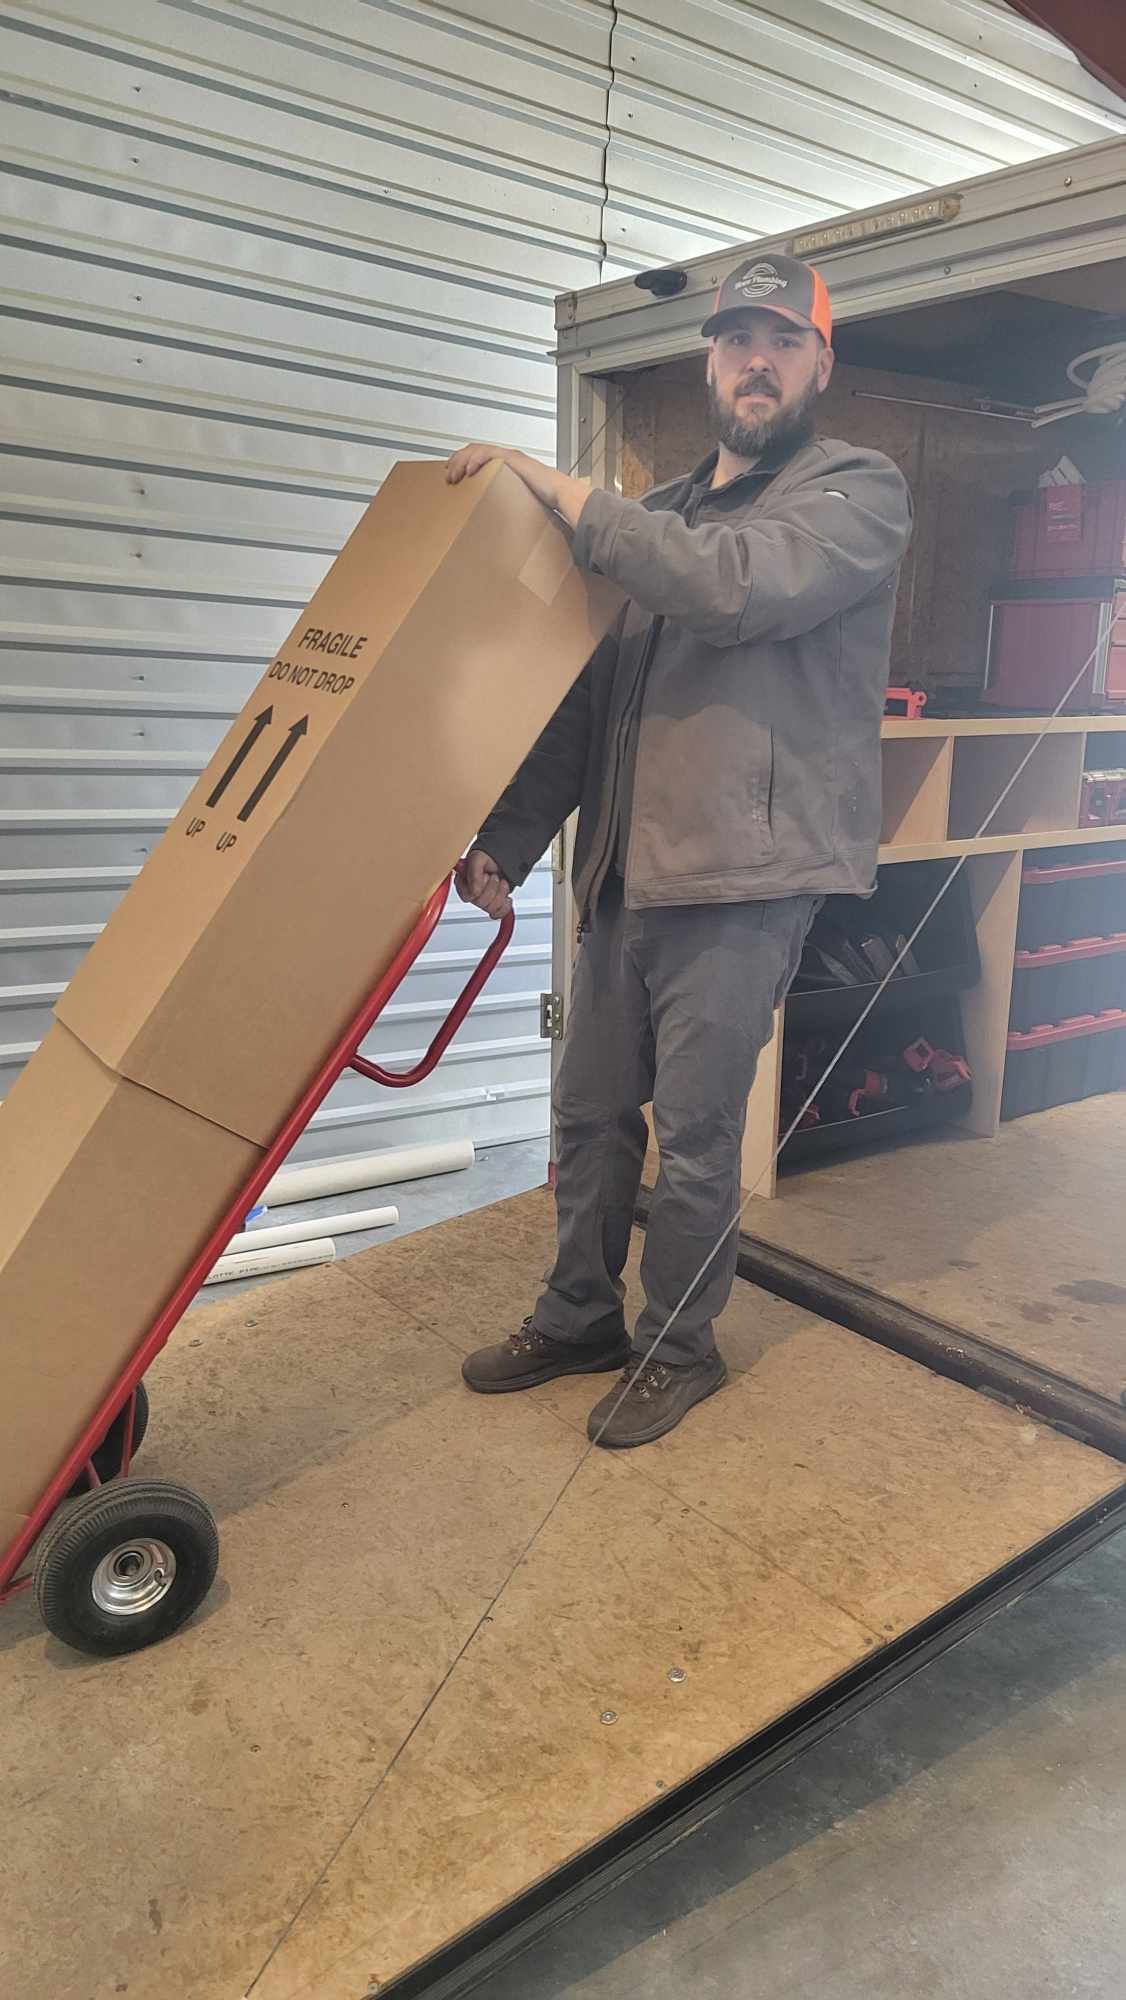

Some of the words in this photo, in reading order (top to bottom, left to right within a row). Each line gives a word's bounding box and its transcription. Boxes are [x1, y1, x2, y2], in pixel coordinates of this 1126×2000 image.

[297, 627, 368, 658] FRAGILE
[268, 660, 291, 681] DO
[287, 664, 319, 688] NOT
[313, 670, 355, 696] DROP
[185, 816, 206, 838] UP
[215, 831, 238, 853] UP
